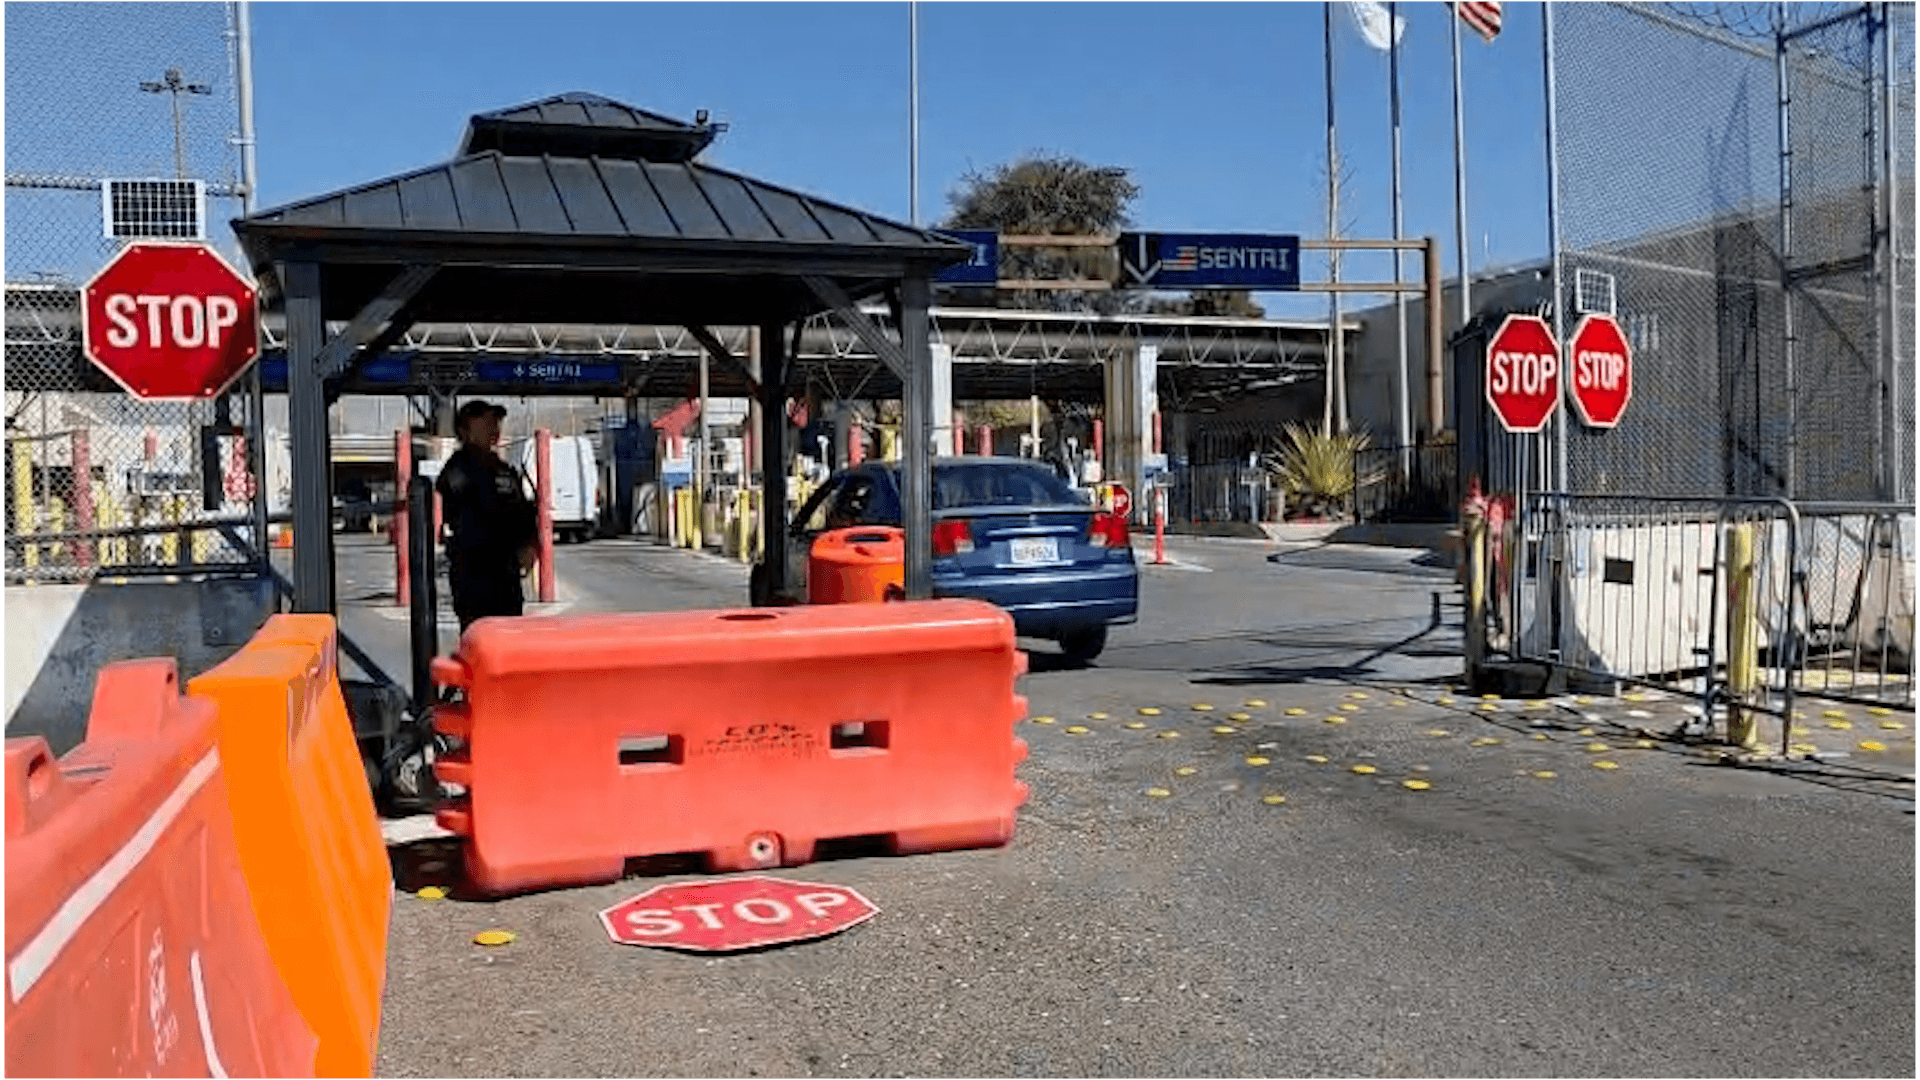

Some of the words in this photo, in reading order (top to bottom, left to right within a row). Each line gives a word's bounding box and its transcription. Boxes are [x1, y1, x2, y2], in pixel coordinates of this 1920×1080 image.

[1200, 247, 1290, 271] SENTRI
[105, 293, 239, 349] STOP
[1492, 350, 1557, 395] STOP
[1577, 350, 1625, 391] STOP
[626, 892, 848, 936] STOP
